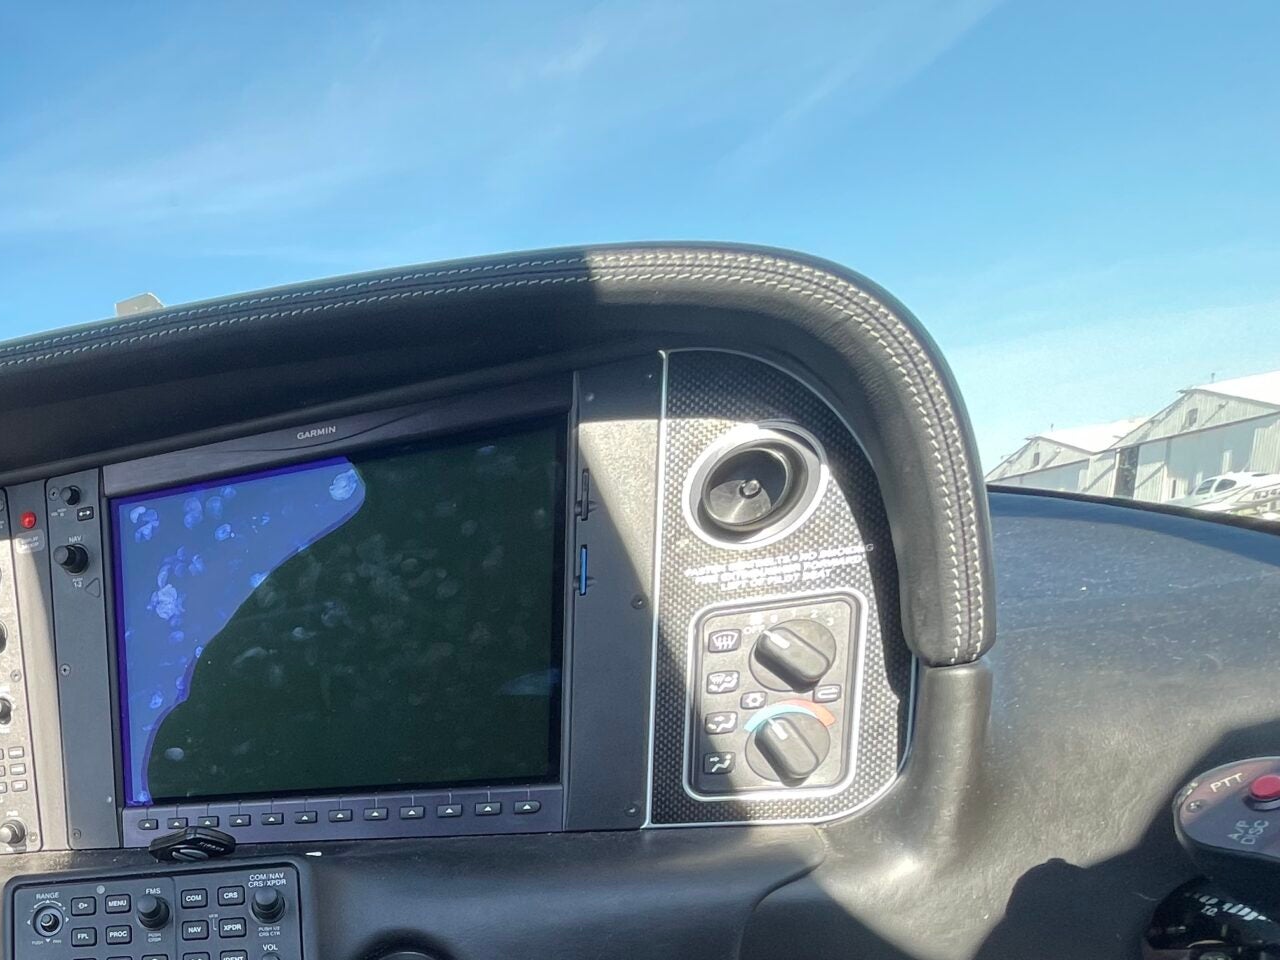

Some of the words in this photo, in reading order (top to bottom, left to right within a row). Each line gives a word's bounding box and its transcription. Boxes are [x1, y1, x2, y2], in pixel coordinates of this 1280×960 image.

[296, 426, 336, 439] GARMIN
[1209, 772, 1244, 793] PTT
[1228, 820, 1250, 840] A/P
[1240, 820, 1269, 846] DISC
[36, 892, 60, 900] RANGE
